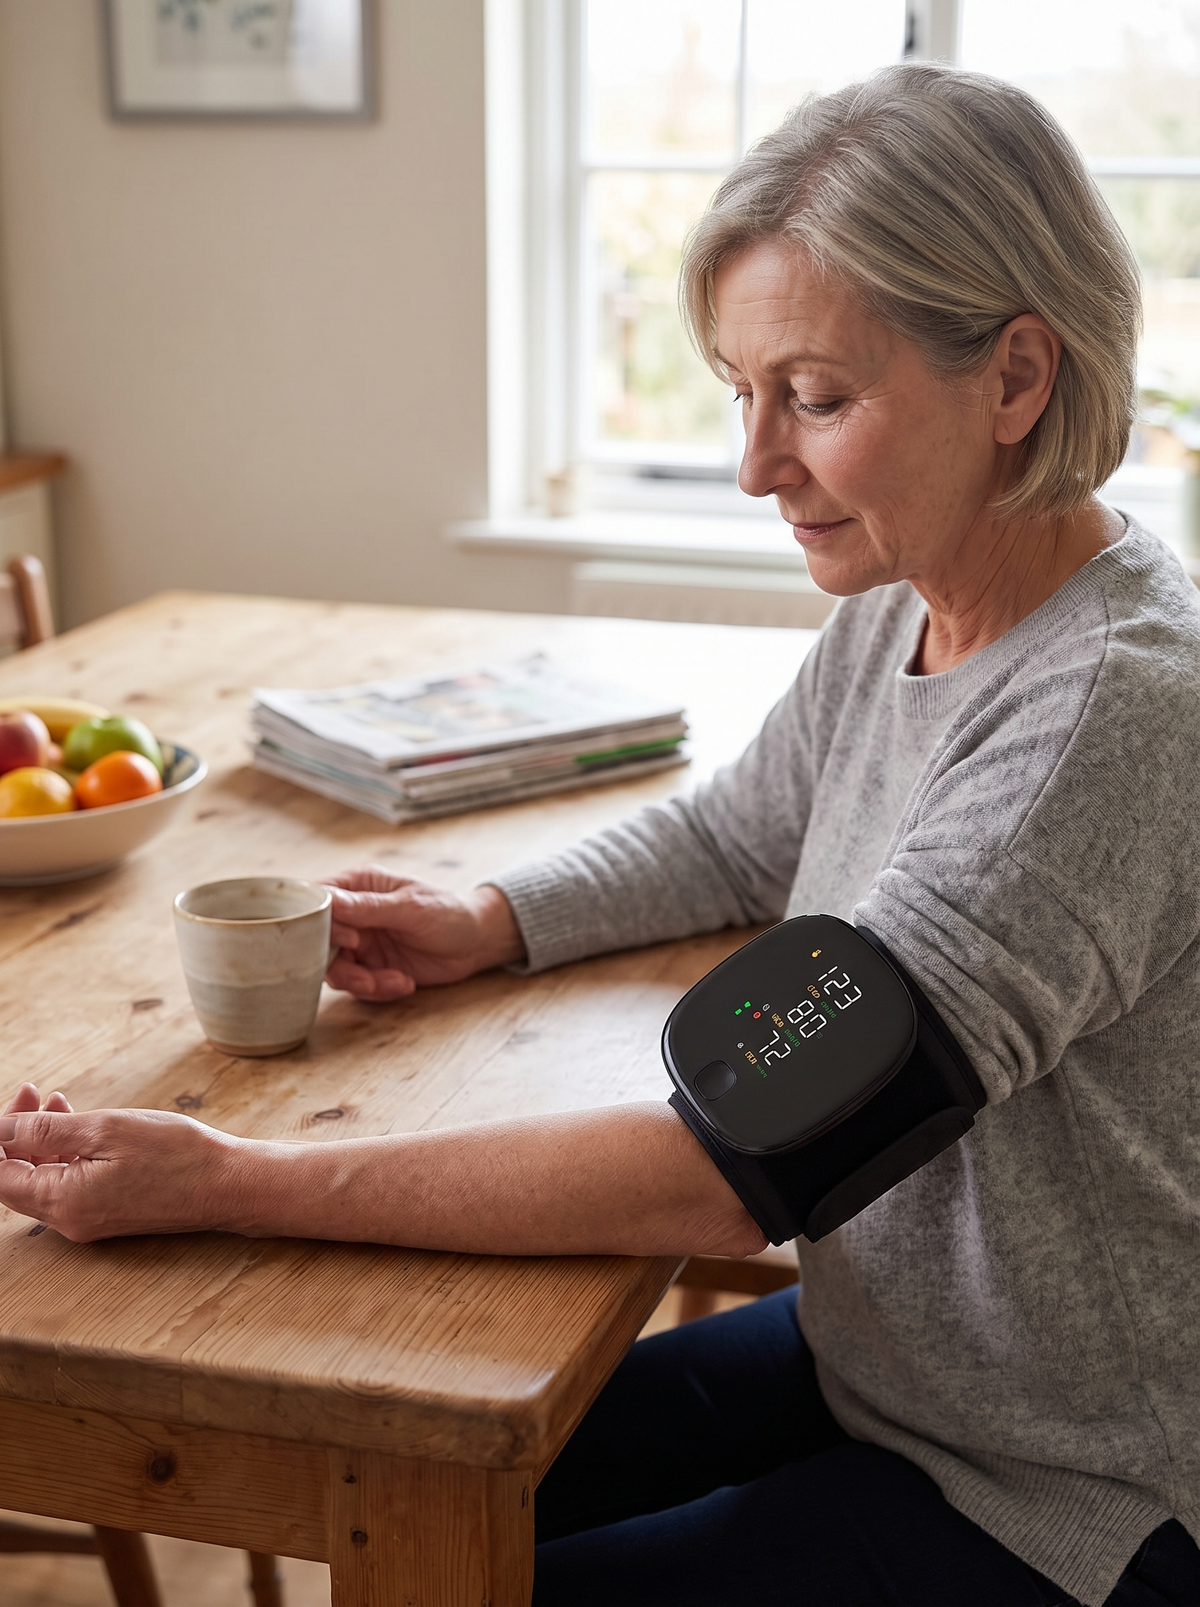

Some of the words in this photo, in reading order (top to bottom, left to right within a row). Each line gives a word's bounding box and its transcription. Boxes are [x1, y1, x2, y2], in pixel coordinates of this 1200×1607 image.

[817, 965, 862, 1010] 123
[787, 999, 827, 1039] 80
[759, 1029, 792, 1066] 72
